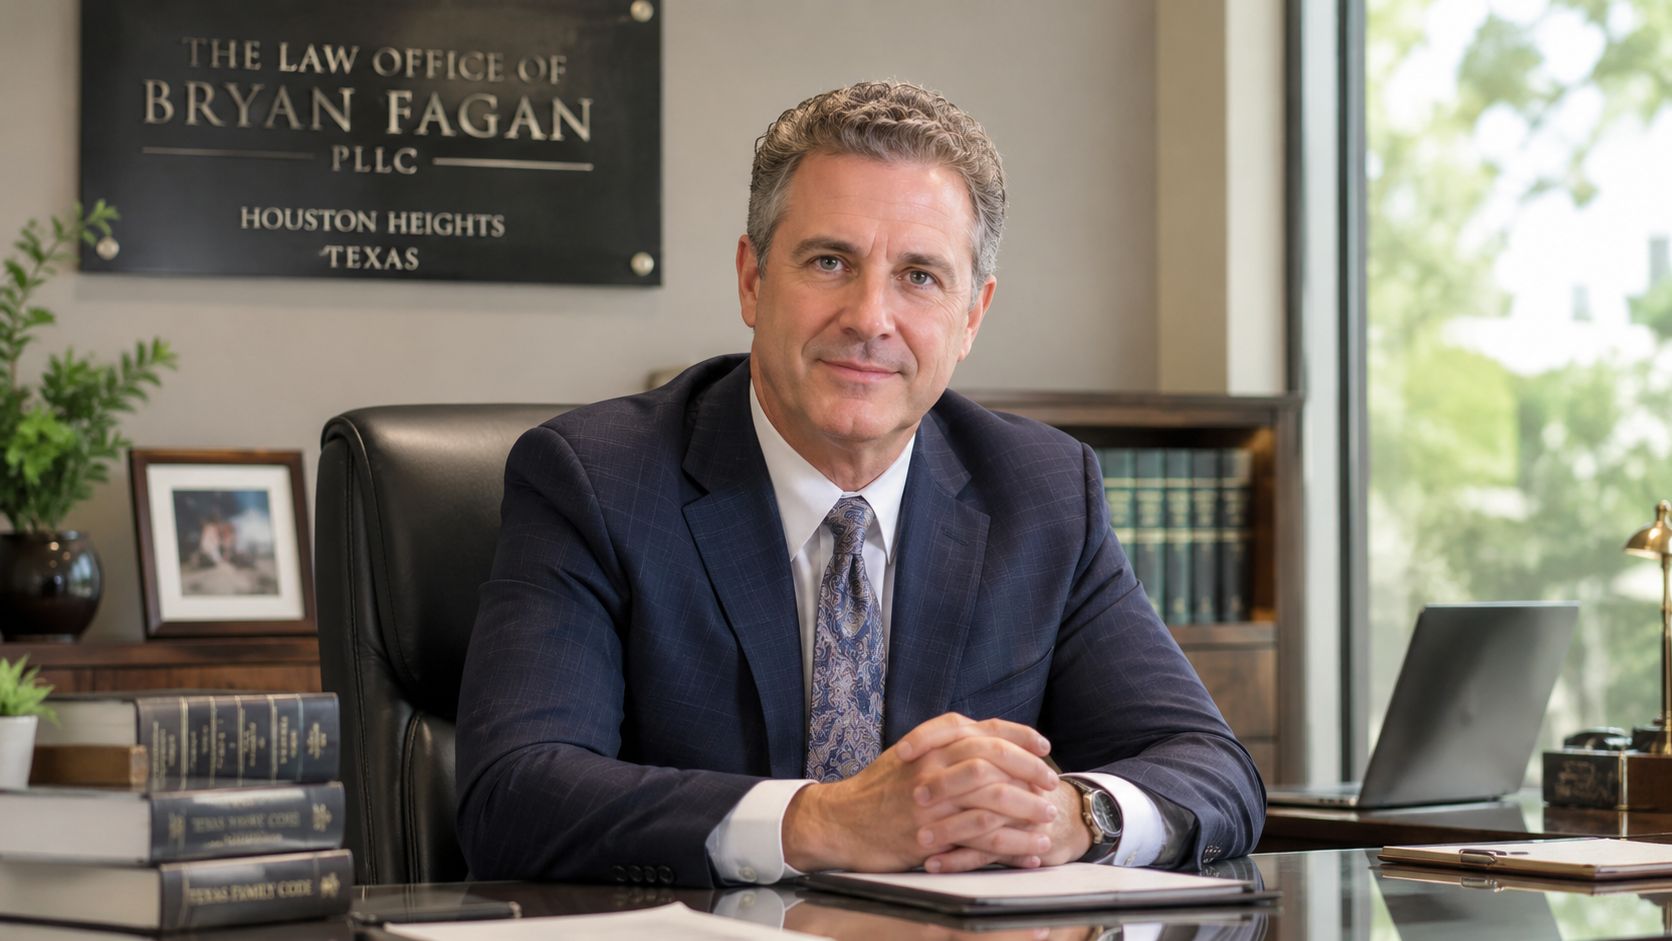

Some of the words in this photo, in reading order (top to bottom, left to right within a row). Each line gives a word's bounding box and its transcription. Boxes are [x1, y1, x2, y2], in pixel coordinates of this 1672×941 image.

[183, 37, 262, 70] THE
[279, 41, 360, 74] LAW
[372, 46, 504, 82] OFFICE
[518, 54, 567, 84] OF
[144, 79, 355, 133] BRYAN
[386, 89, 594, 142] FAGAN
[331, 145, 418, 174] PLLC
[240, 206, 377, 233] HOUSTON
[387, 211, 505, 237] HEIGHTS
[319, 245, 419, 271] TEXAS
[277, 879, 312, 898] CODE
